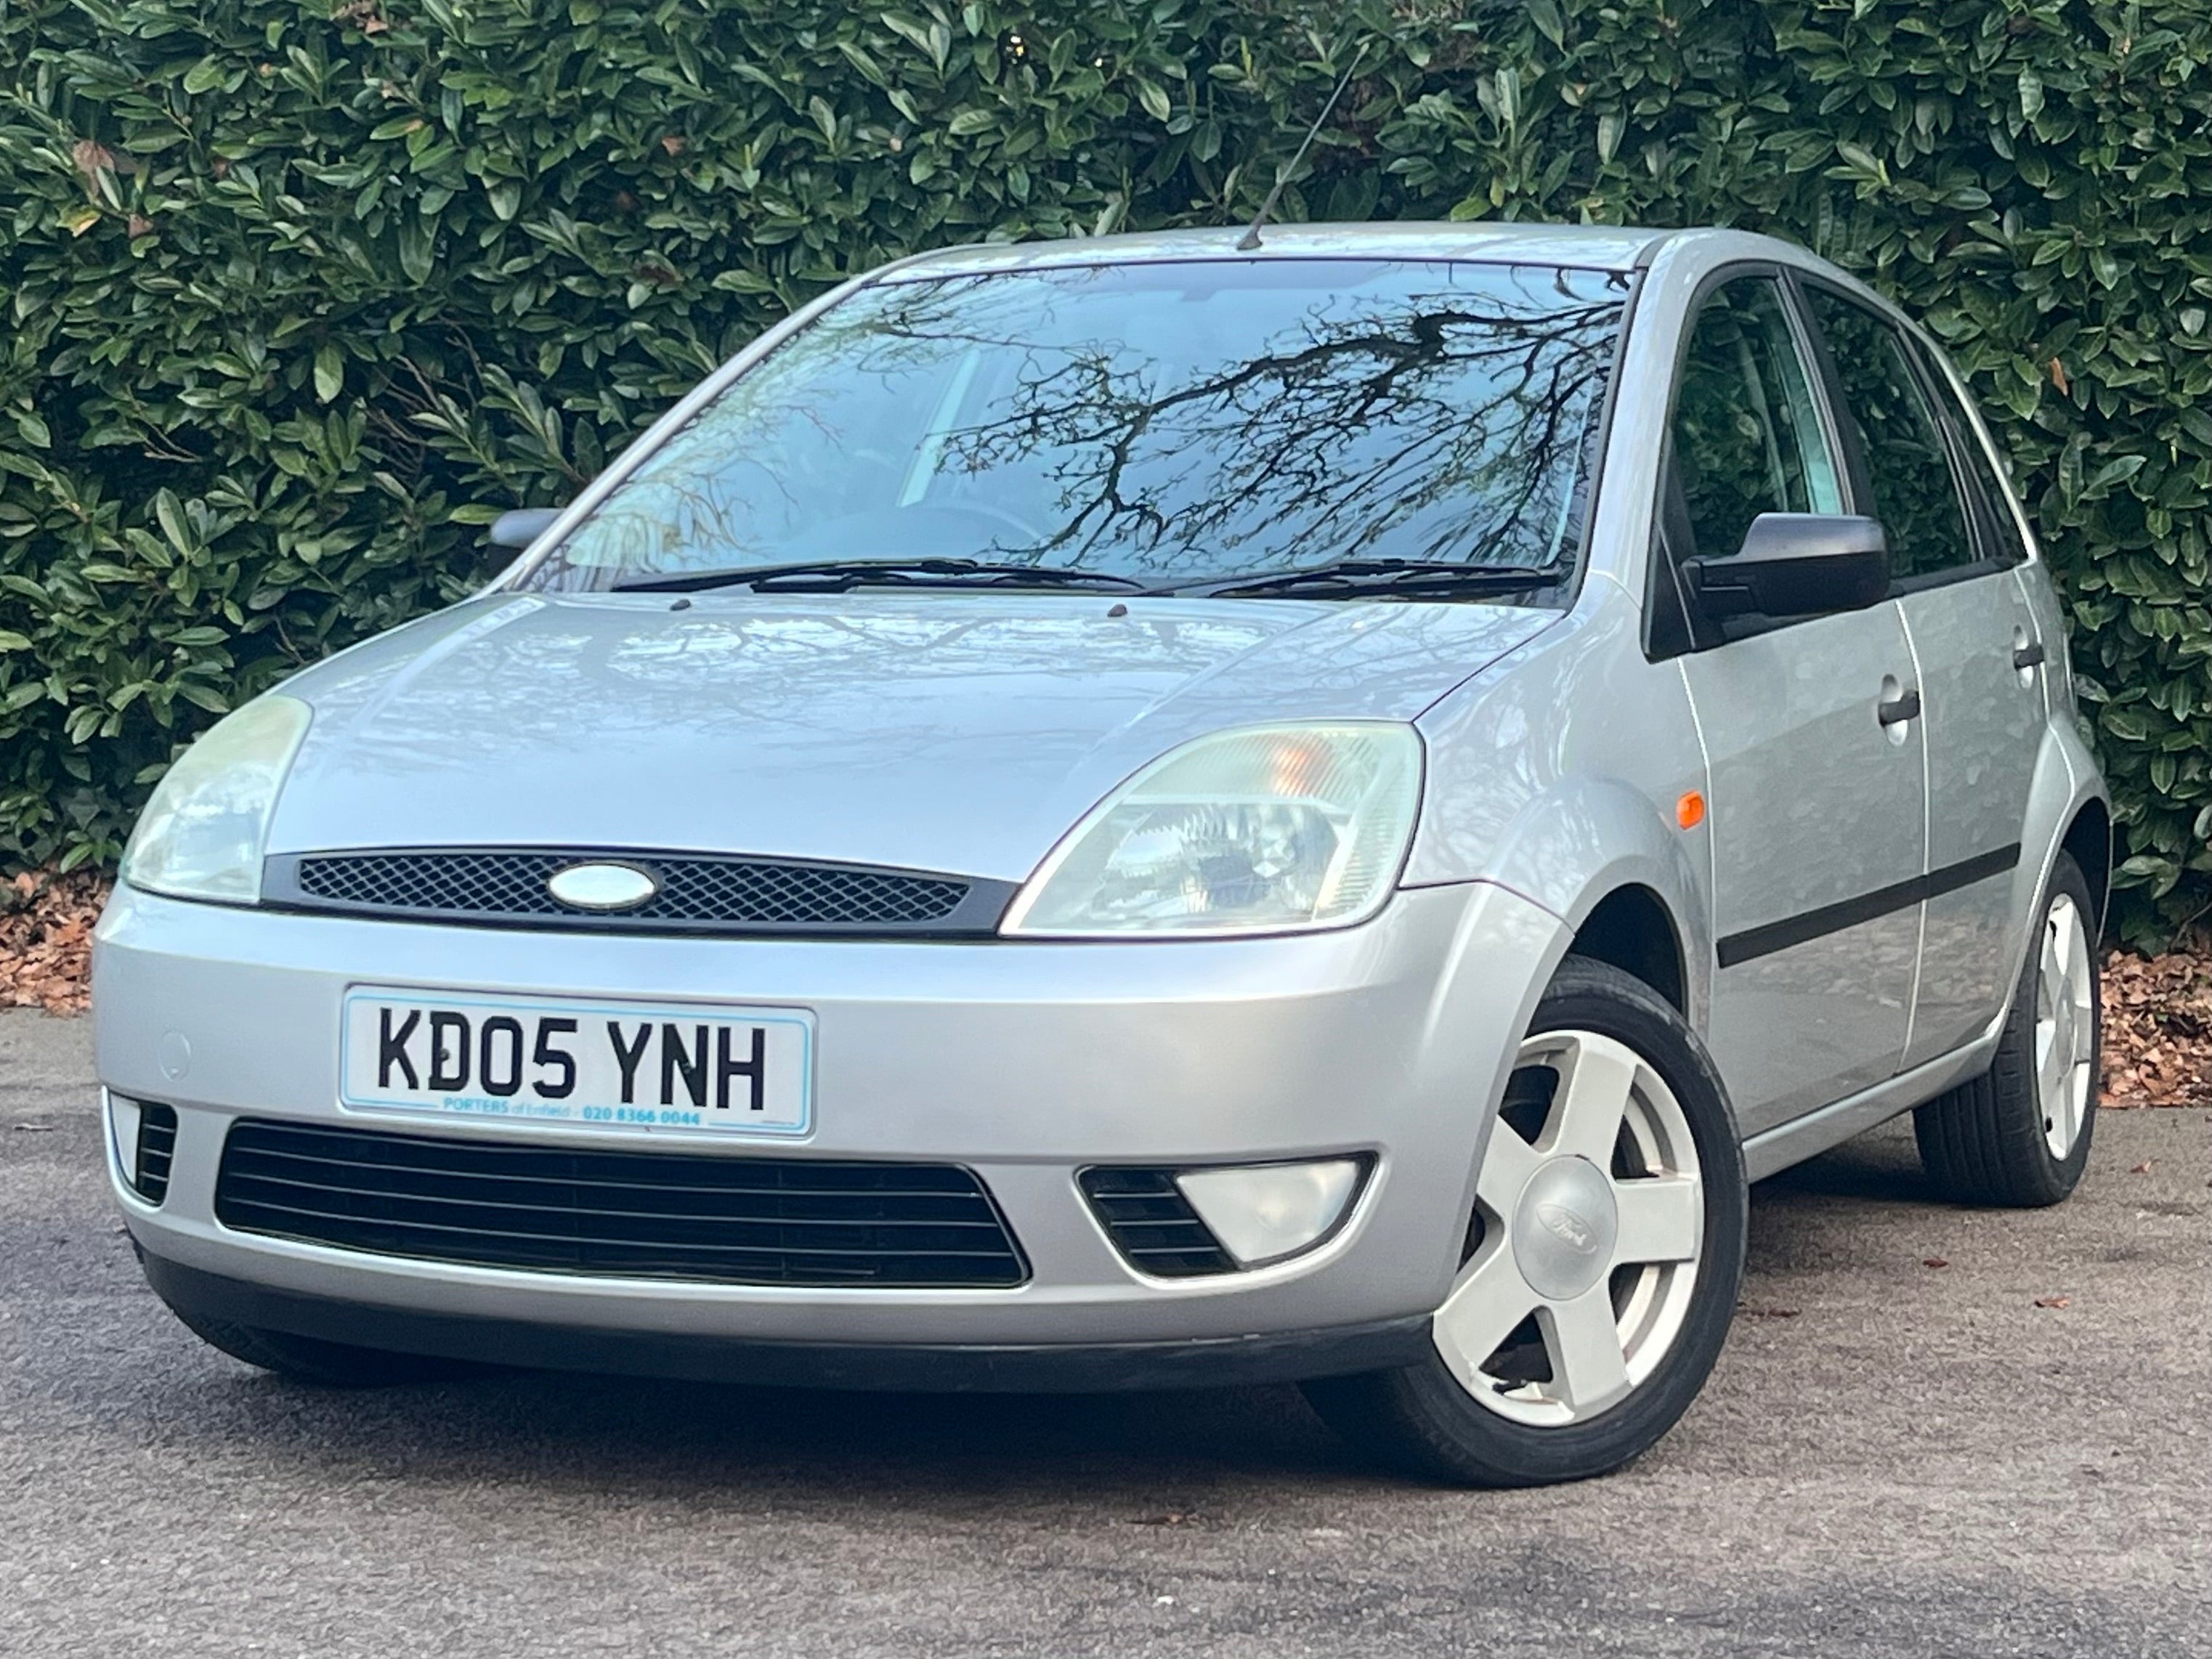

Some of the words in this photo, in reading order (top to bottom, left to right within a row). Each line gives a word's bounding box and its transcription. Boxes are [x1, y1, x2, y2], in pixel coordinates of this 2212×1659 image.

[378, 1007, 578, 1099] KD05
[607, 1021, 765, 1110] YNH
[443, 1098, 508, 1114] PORTERS
[511, 1103, 524, 1114] of
[583, 1106, 612, 1120] 020
[618, 1108, 655, 1123] 8366
[660, 1111, 700, 1125] 0044
